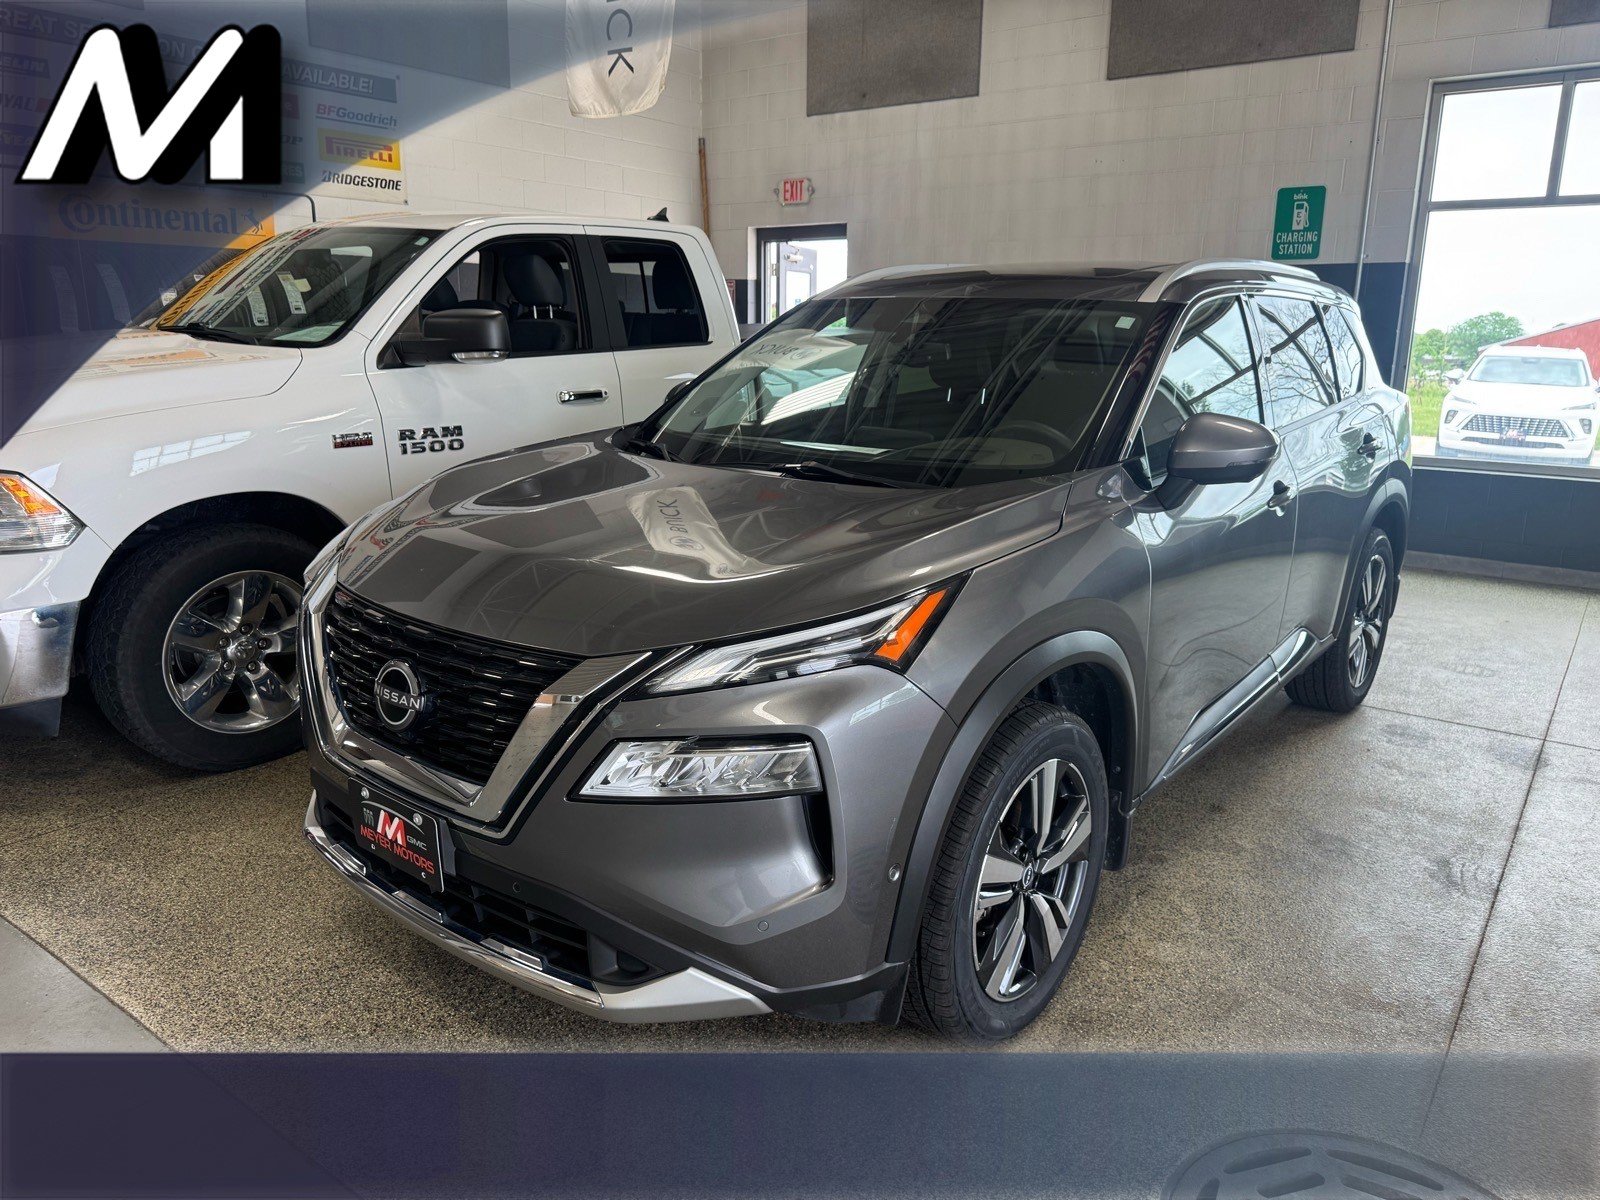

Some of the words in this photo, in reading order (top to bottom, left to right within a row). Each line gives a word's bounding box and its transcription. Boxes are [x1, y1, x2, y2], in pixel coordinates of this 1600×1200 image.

[605, 0, 635, 78] CK
[282, 62, 375, 94] AVAILABLE!
[316, 103, 398, 128] BFGoodrich
[324, 136, 394, 163] PIRELLI
[321, 170, 402, 192] BRIDGESTONE
[783, 178, 805, 202] EXIT
[59, 192, 239, 235] Continental
[1276, 231, 1318, 243] CHARGING
[1278, 243, 1313, 255] STATION
[398, 425, 463, 441] RAM
[399, 438, 464, 455] 1500
[376, 684, 421, 709] NISSAN
[360, 824, 392, 851] MEYER
[393, 843, 435, 875] MOTORS
[406, 835, 427, 851] GMC
